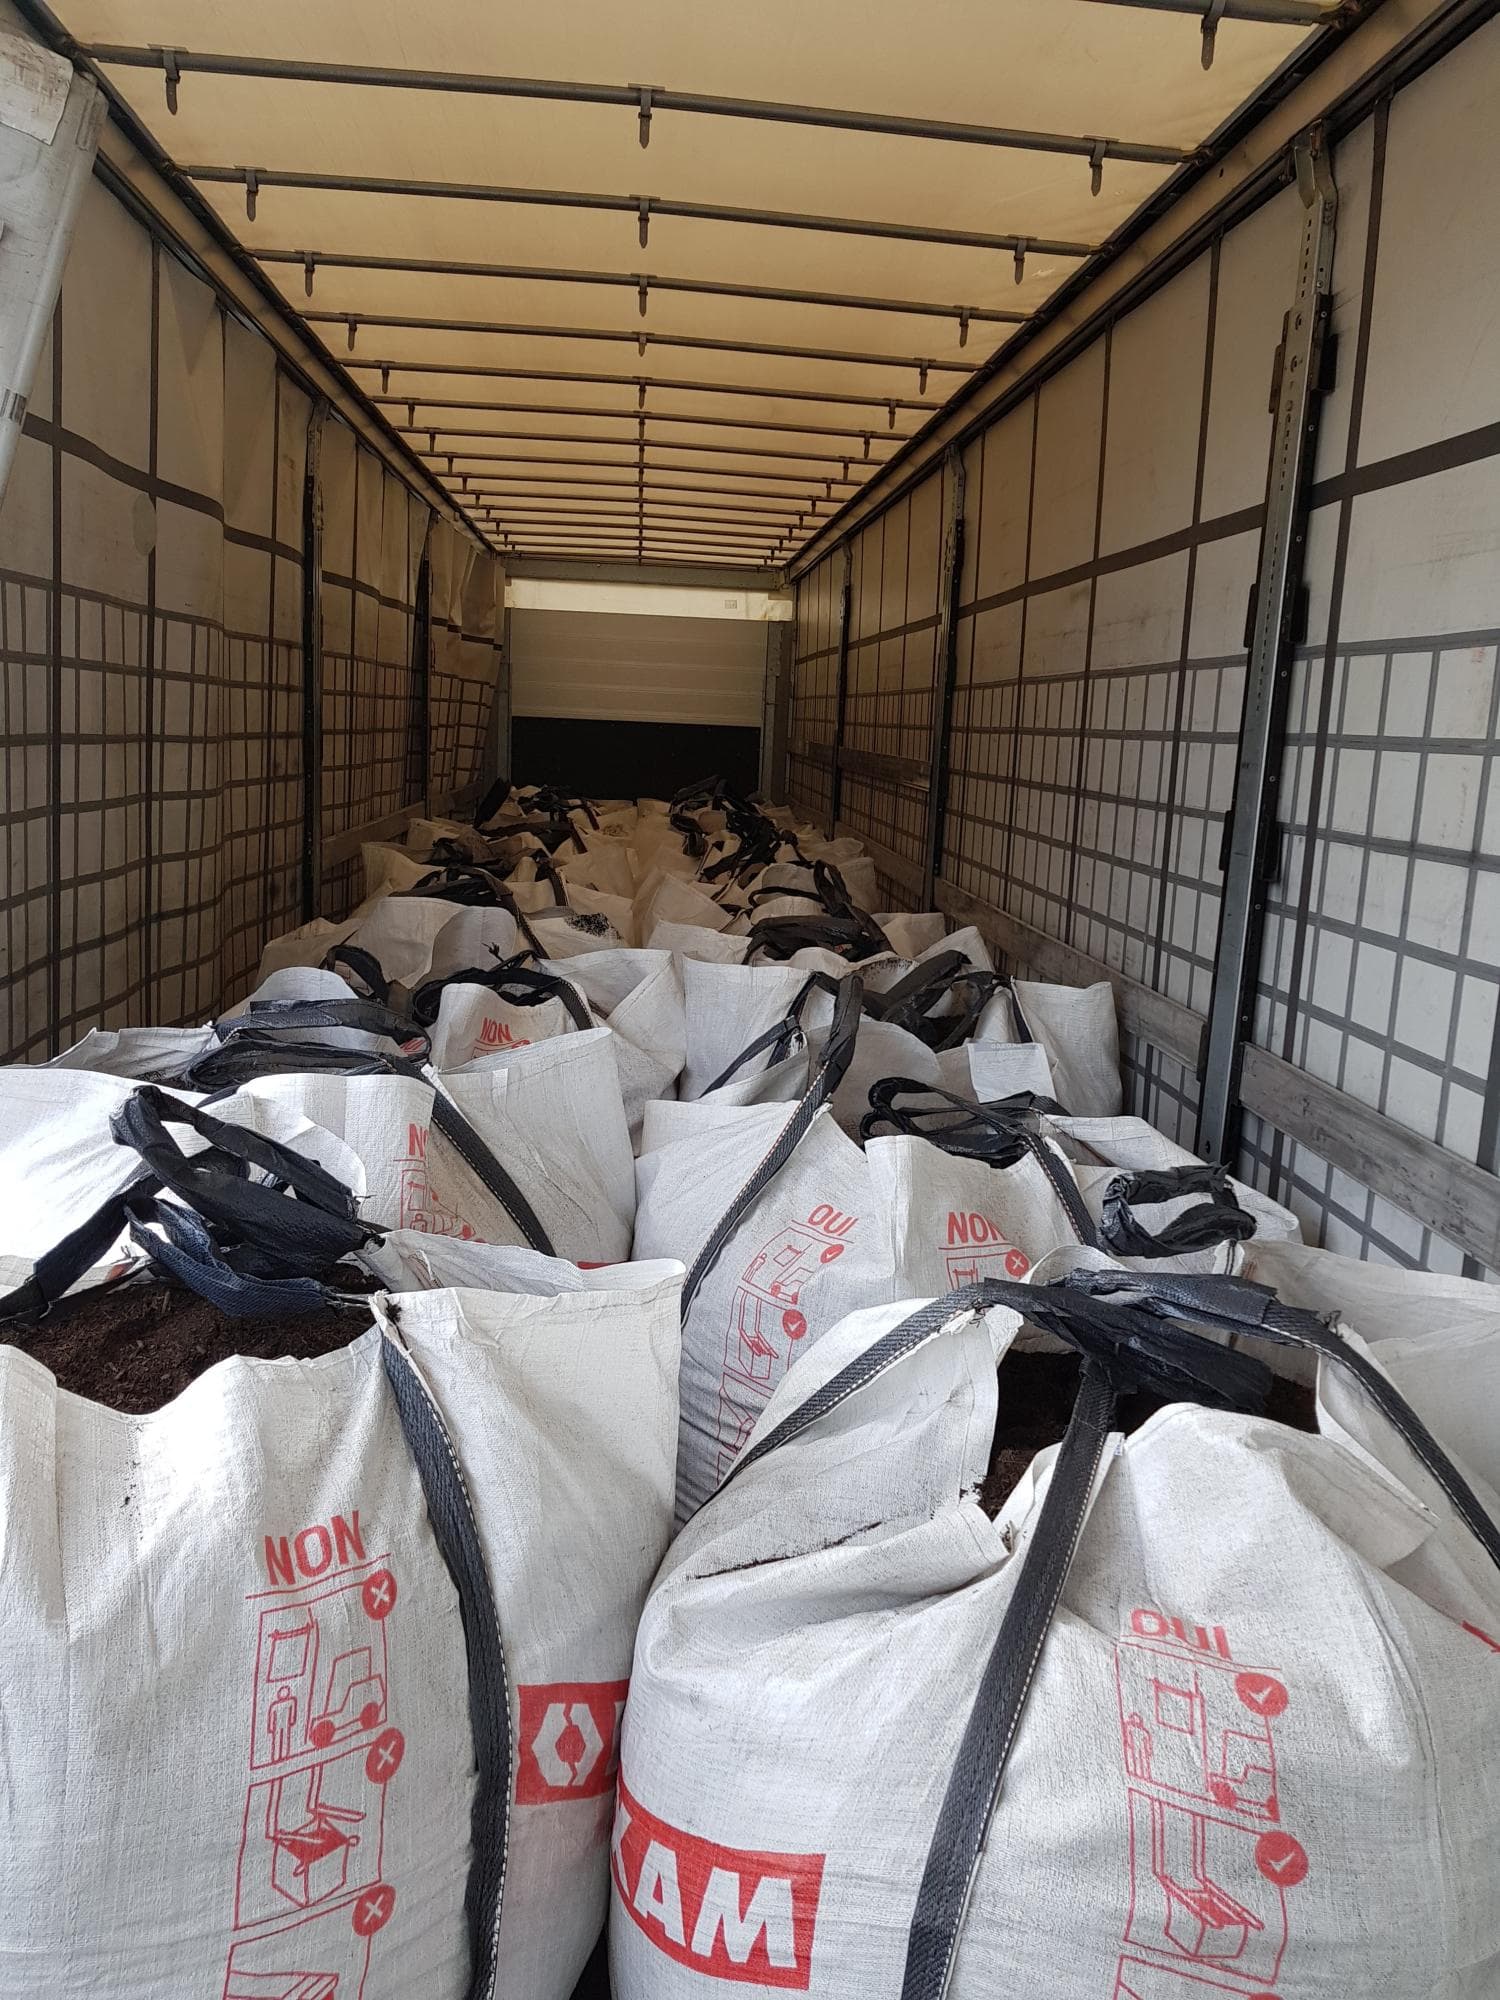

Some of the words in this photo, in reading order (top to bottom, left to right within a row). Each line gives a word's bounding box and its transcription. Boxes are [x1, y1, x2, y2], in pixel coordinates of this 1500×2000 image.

[480, 1017, 513, 1043] NON
[808, 1204, 859, 1236] OUI
[264, 1509, 367, 1586] NON
[1131, 1608, 1233, 1661] OUI
